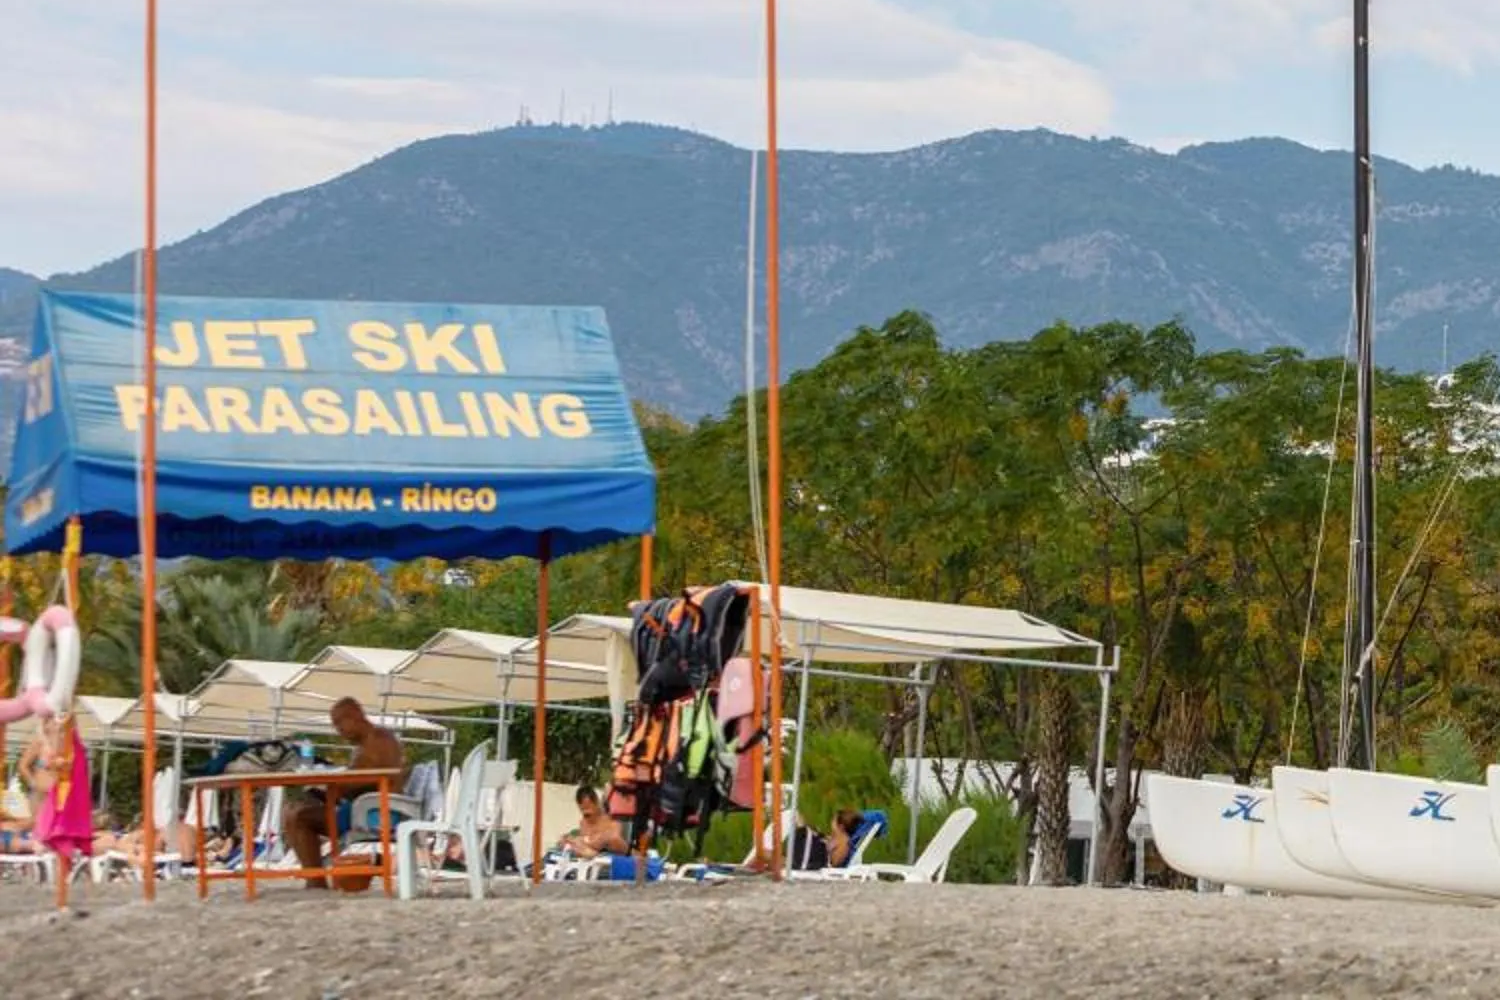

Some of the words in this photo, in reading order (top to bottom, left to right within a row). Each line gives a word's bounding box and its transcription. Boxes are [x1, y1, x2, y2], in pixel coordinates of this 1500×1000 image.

[153, 319, 316, 369] JET
[348, 320, 506, 373] SKI
[114, 383, 593, 438] PARASAILING
[251, 485, 376, 511] BANANA
